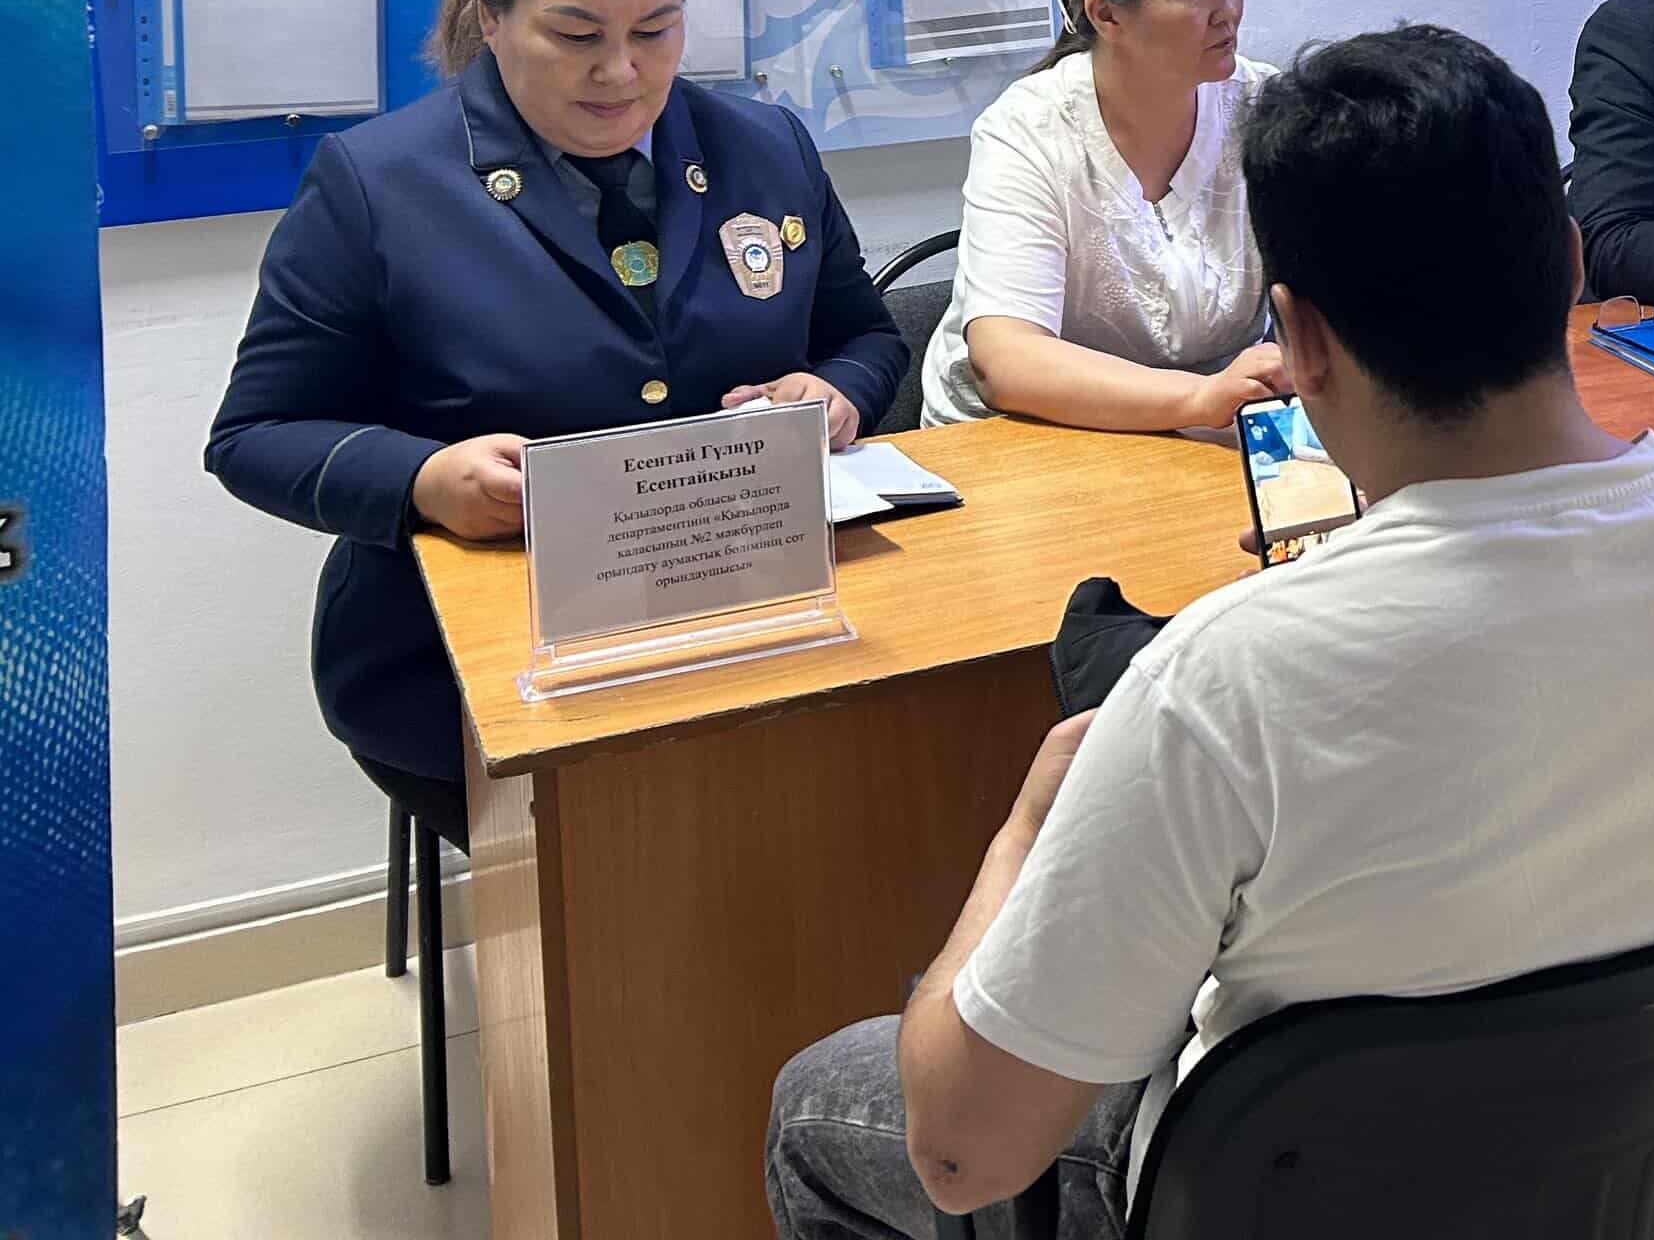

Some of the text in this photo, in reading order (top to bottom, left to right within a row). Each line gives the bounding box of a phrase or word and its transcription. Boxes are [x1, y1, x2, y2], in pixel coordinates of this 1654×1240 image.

[623, 448, 697, 473] Есентай
[613, 484, 782, 523] Қызылорда облысы Әділет
[784, 532, 806, 545] сот
